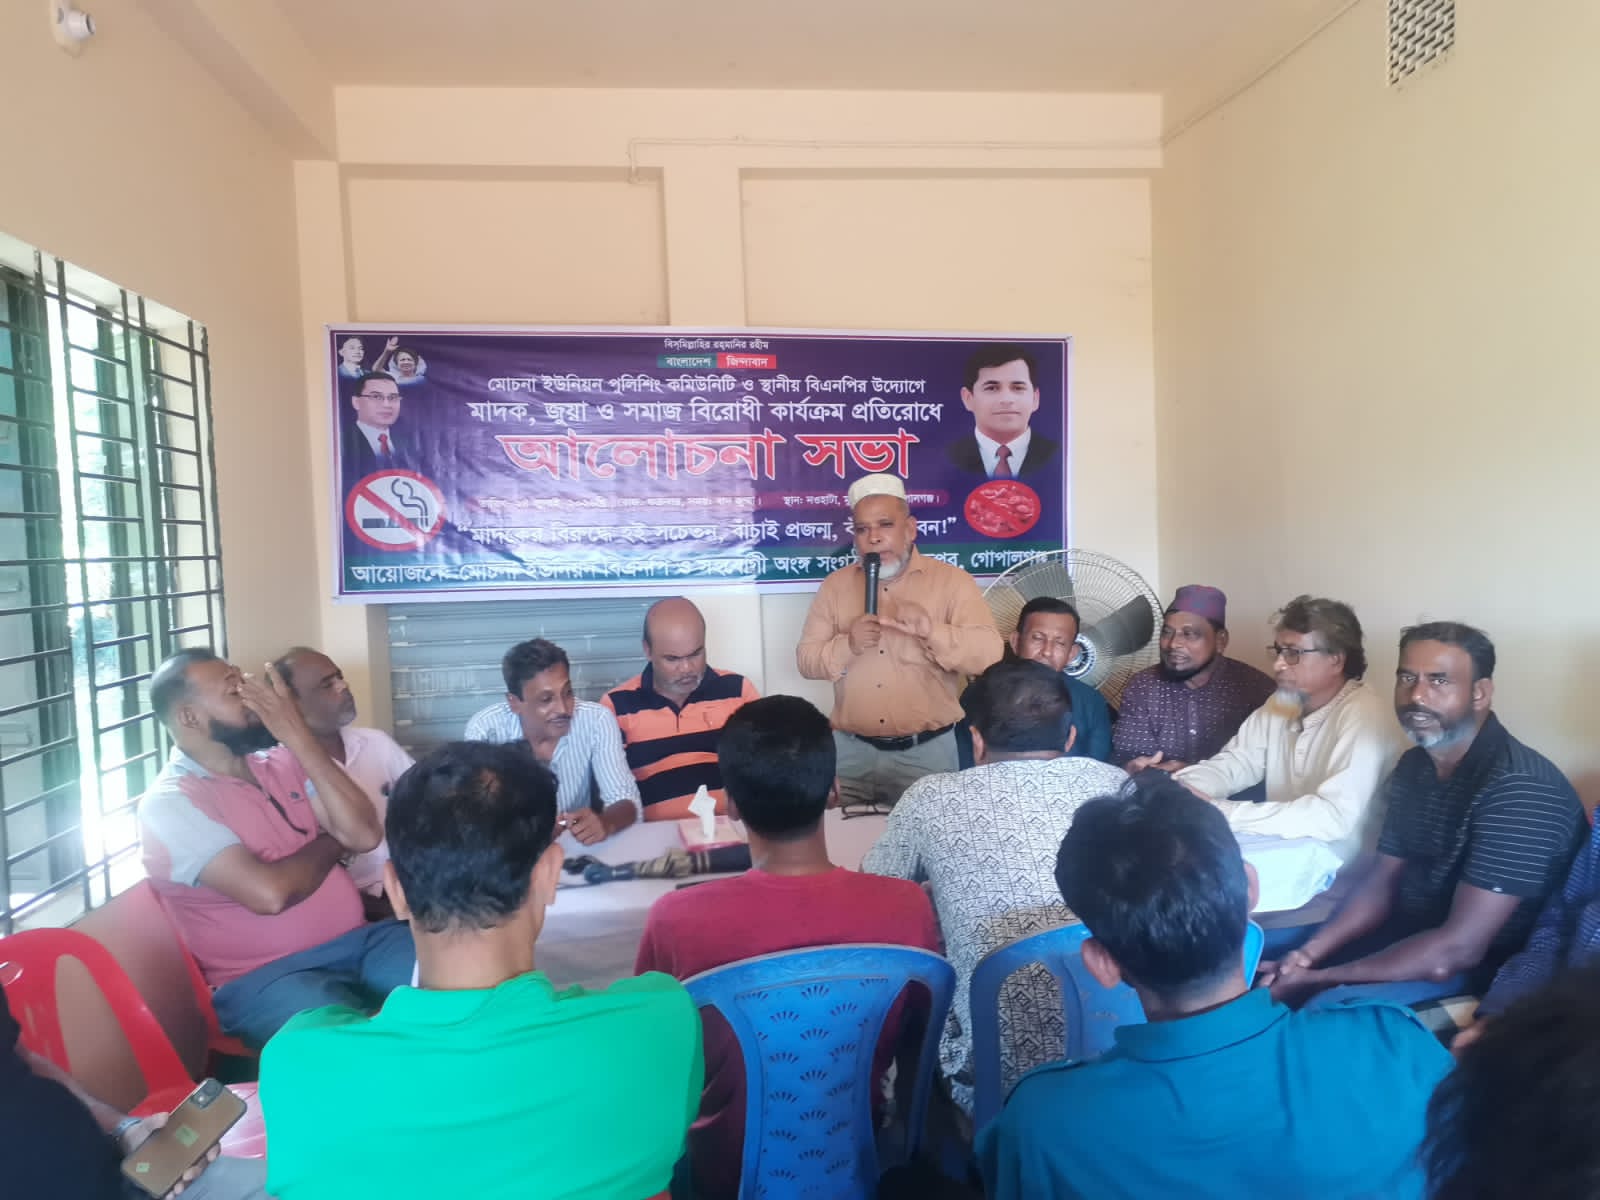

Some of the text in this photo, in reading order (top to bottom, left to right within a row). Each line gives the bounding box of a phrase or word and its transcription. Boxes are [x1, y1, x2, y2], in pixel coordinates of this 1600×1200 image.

[665, 355, 768, 368] বাংলাদেশ জিন্দাবাদ
[488, 373, 926, 396] মোচনা ইউনিয়ন পুলিশিং কমিউনিটি ও স্থানীয় বিএনপির উদ্যোগে
[466, 395, 944, 426] মাদক, জুয়া ও সমাজ বিরোধী কার্যক্রম প্রতিরোধে
[494, 427, 920, 481] আলোচনা সভা
